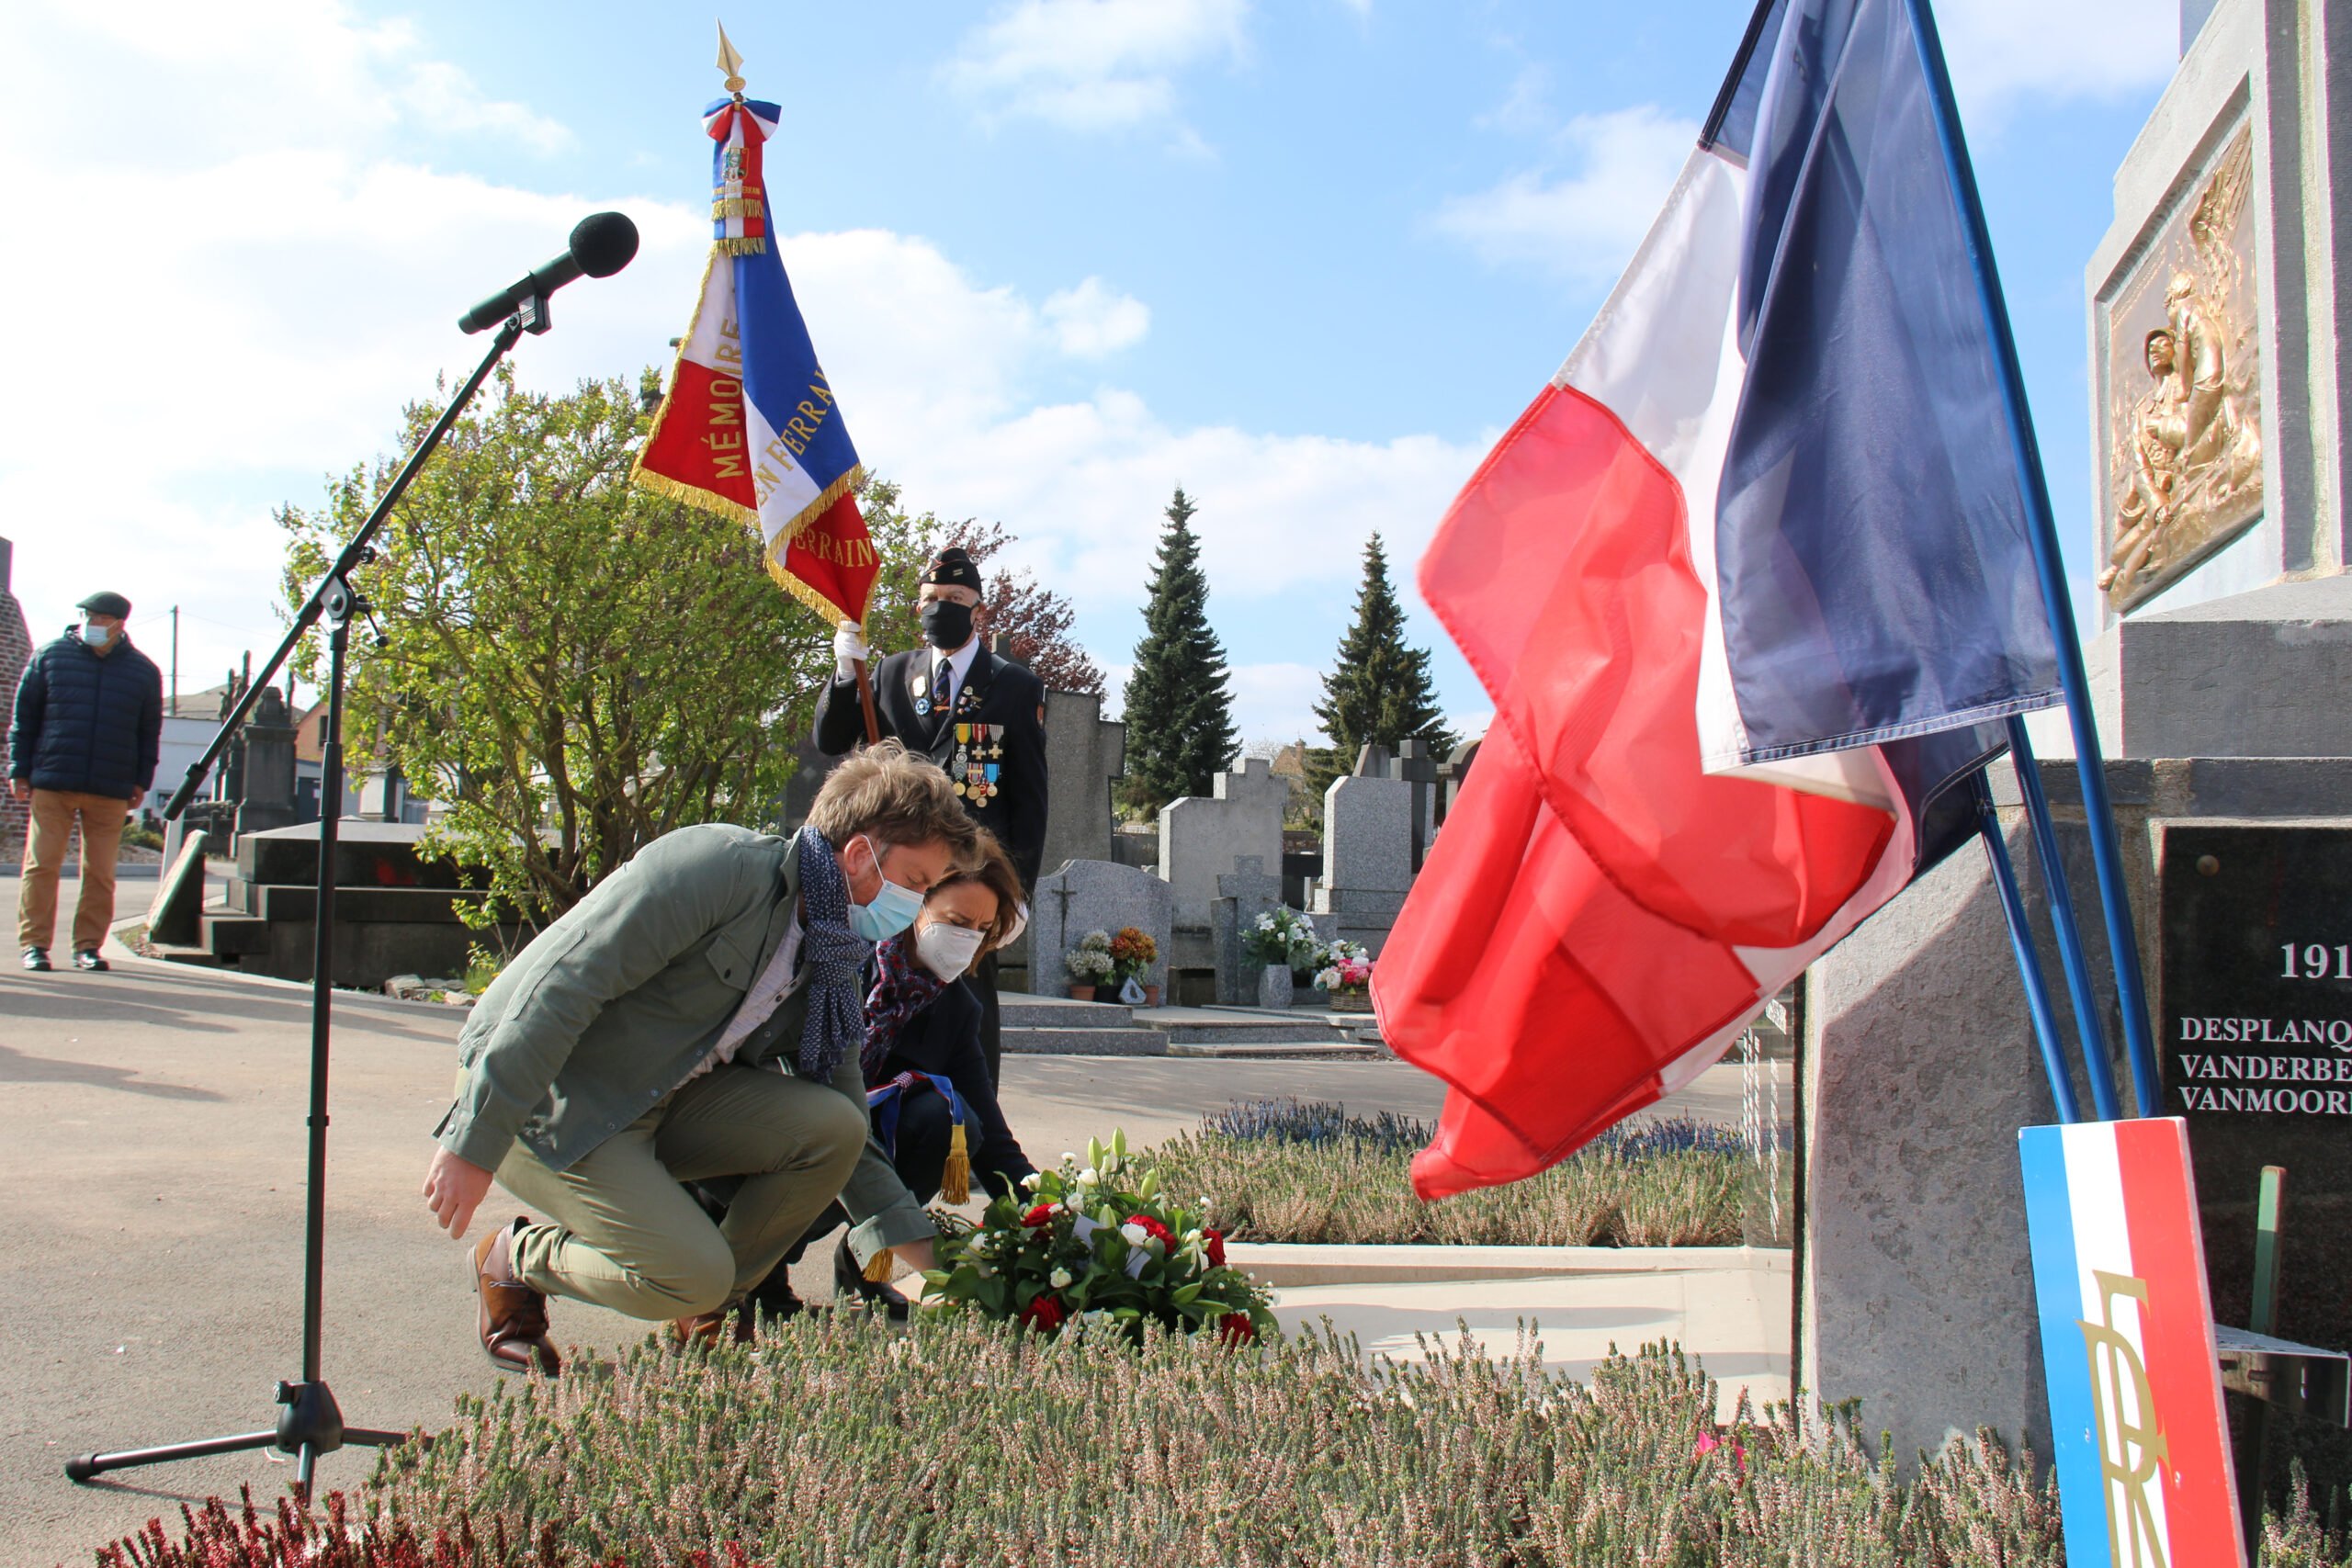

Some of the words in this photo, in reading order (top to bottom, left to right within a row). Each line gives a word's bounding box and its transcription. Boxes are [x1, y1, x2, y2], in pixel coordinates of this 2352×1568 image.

[701, 318, 744, 479] MÉMOIRE
[2281, 942, 2352, 979] 191
[2180, 1017, 2352, 1053] DESPLANQ
[2178, 1055, 2352, 1082] VANDERBE
[2178, 1086, 2352, 1114] VANMOOR
